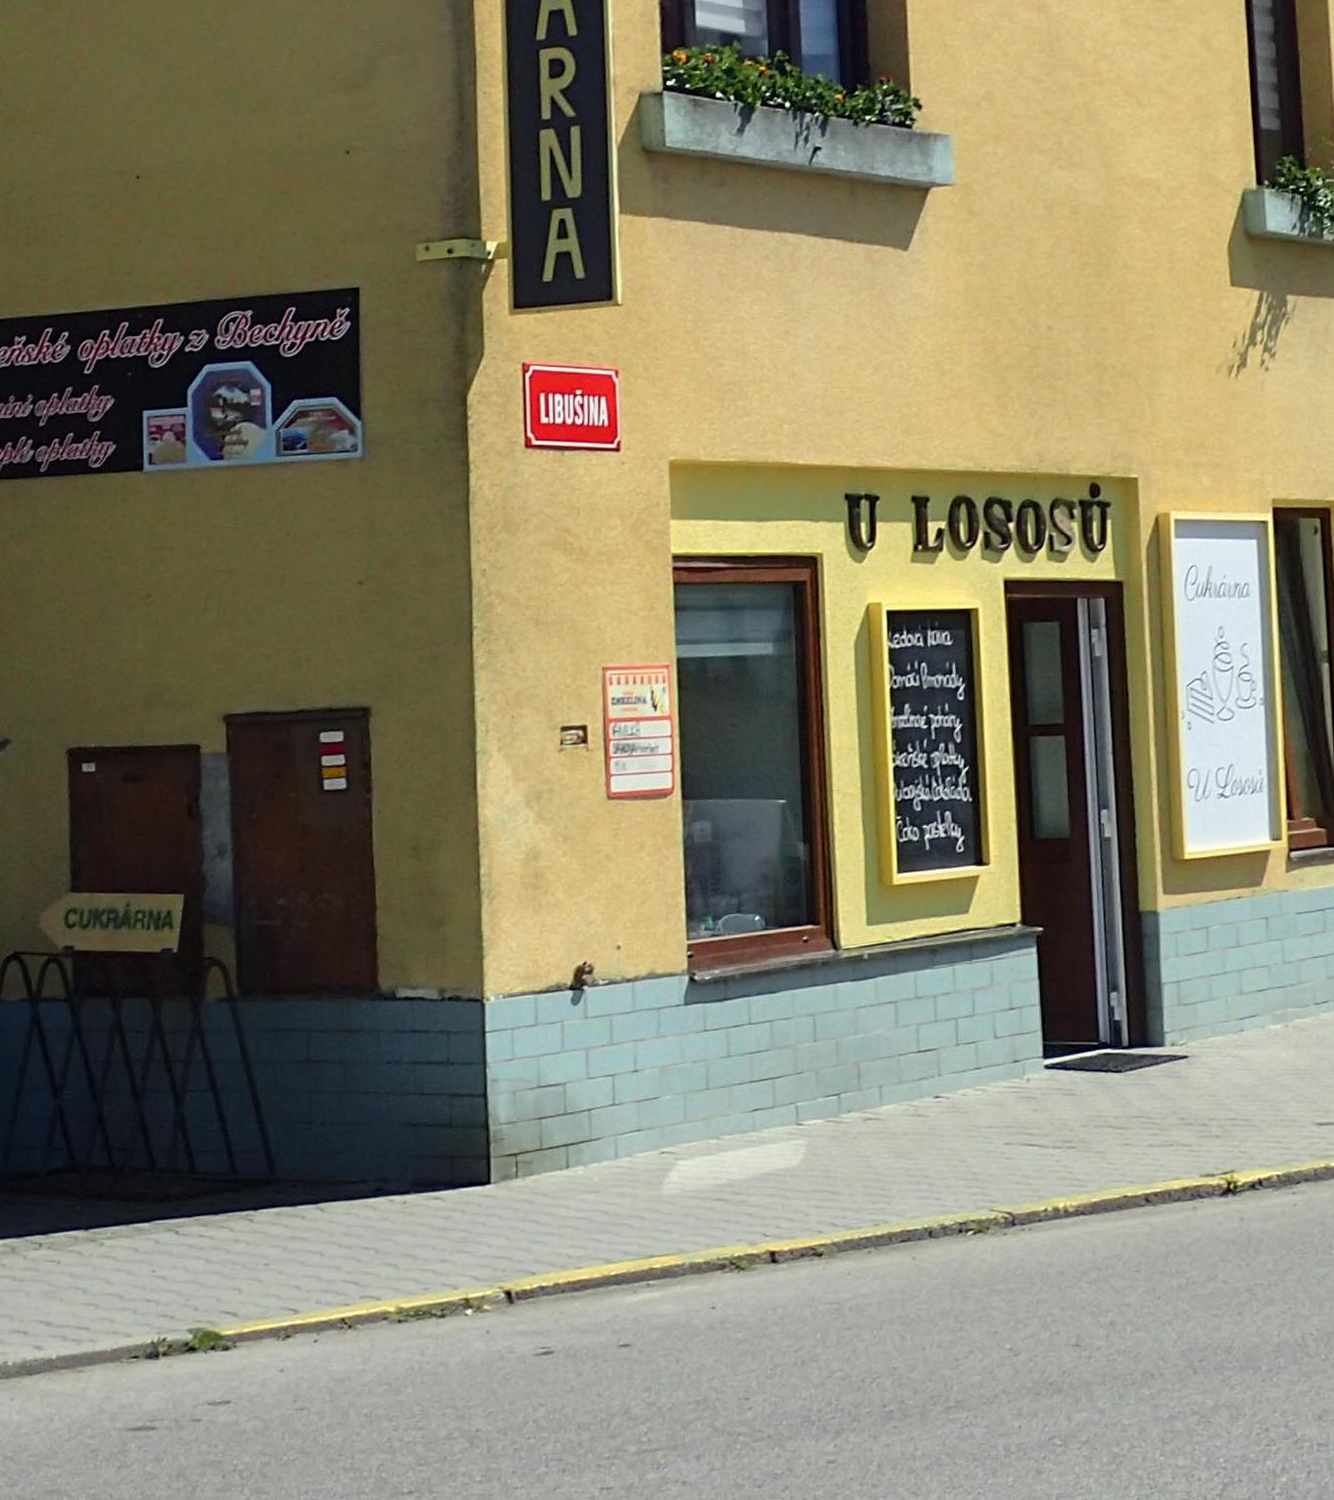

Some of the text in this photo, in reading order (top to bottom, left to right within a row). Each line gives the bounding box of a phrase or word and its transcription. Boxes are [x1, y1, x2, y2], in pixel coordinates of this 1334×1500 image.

[77, 319, 184, 374] oplatky
[186, 328, 209, 352] z
[216, 307, 352, 358] Bechyně
[34, 385, 115, 426] oplatky
[538, 387, 611, 428] LIBUŠINA
[35, 431, 116, 471] oplatky
[845, 482, 1111, 554] U LOSOSŮ
[1183, 564, 1251, 602] Cukrárna
[1187, 768, 1213, 803] U
[63, 901, 174, 934] CUKRÁRNA
